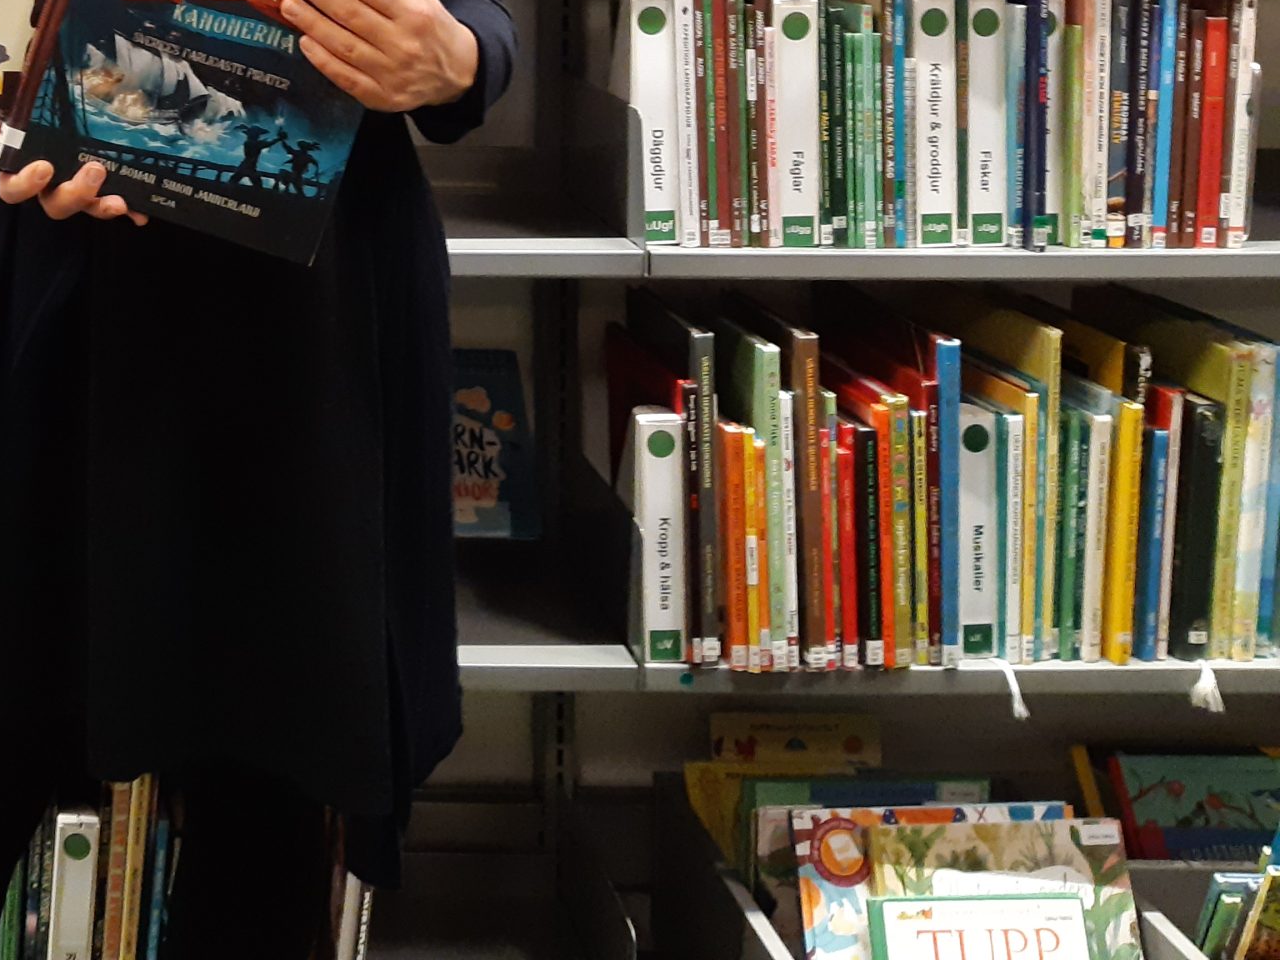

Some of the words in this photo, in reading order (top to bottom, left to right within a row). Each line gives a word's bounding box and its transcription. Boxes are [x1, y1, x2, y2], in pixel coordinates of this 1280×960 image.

[172, 2, 296, 55] KANONERNA
[245, 64, 292, 92] PIRATER
[928, 61, 944, 118] Kräldjur
[930, 123, 942, 133] &
[649, 128, 665, 192] Däggdjur
[789, 150, 805, 195] Fåglar
[927, 135, 943, 195] groddjur
[979, 150, 993, 194] Fiskar
[657, 516, 673, 558] Kropp
[971, 524, 986, 593] Musikalier
[659, 561, 672, 571] &
[658, 574, 673, 611] hälsa
